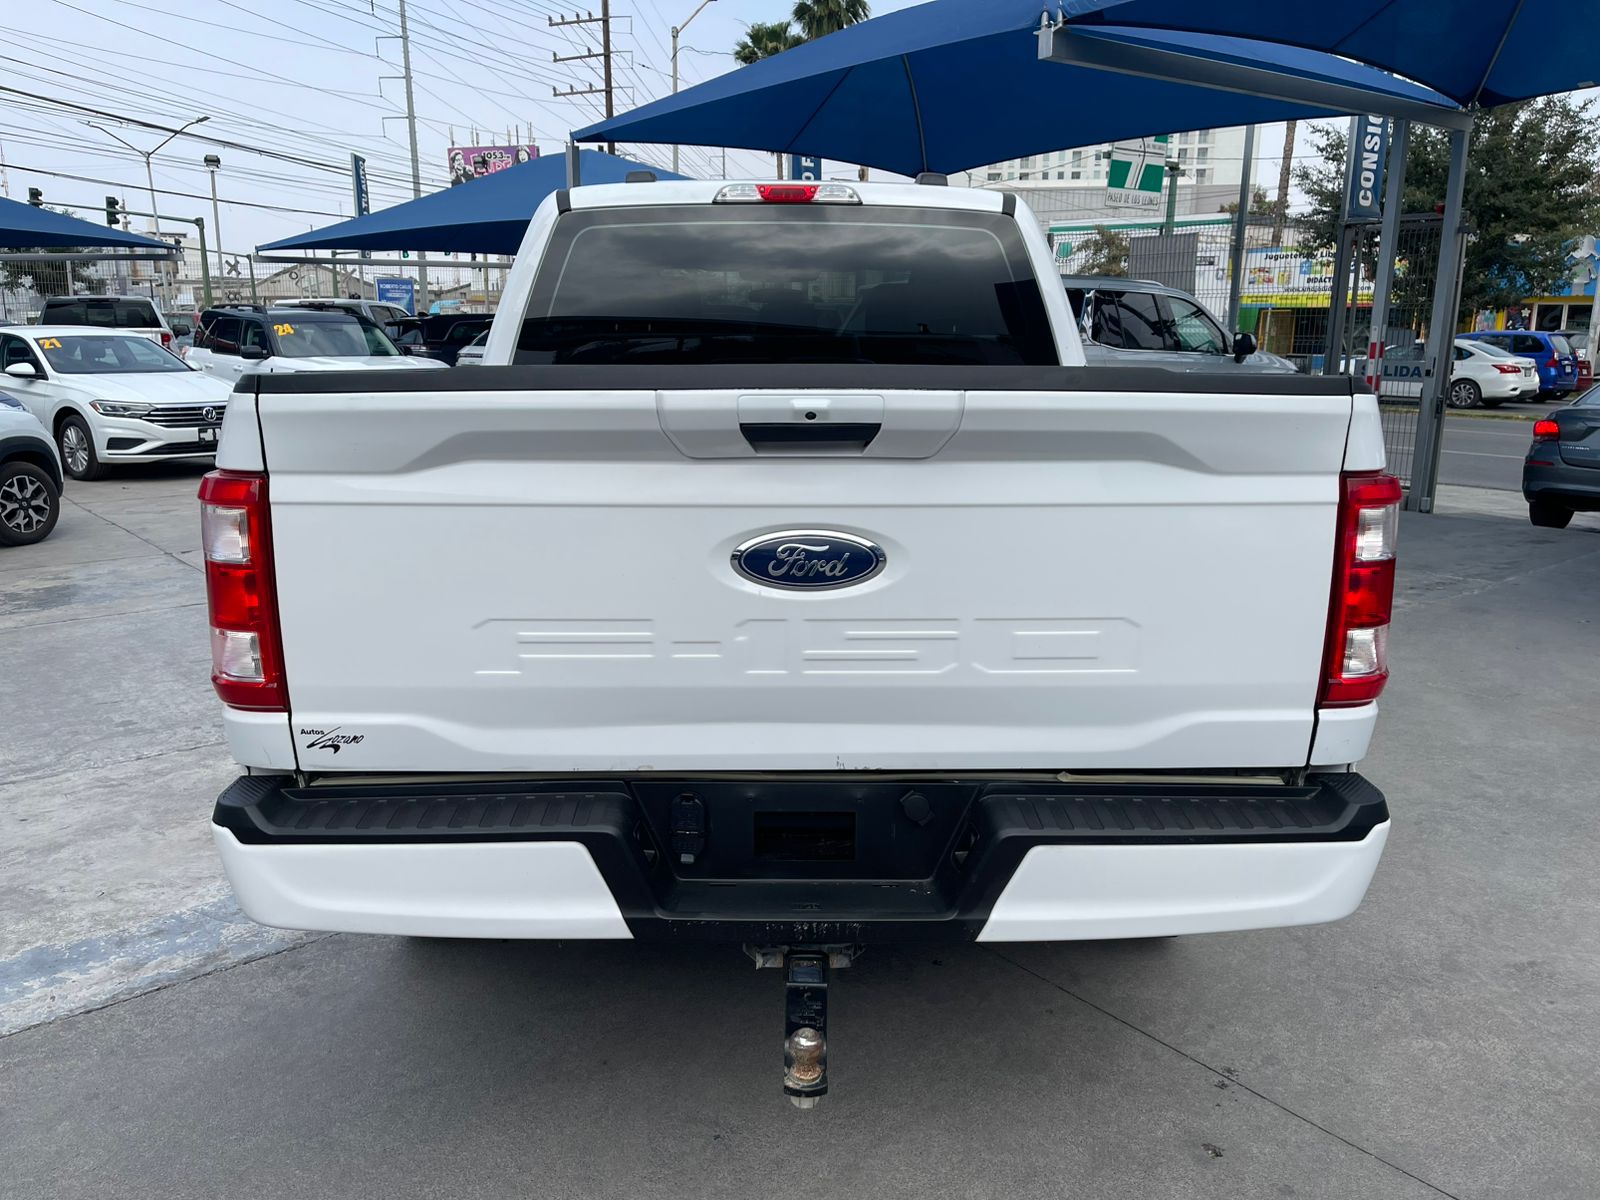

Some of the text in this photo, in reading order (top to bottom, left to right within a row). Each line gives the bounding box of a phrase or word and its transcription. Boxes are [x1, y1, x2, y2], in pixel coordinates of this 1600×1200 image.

[1107, 192, 1123, 203] PASEO
[1124, 193, 1130, 204] DE
[1306, 276, 1333, 284] DIDÁCT
[273, 323, 294, 336] 24
[39, 338, 62, 349] 21
[767, 543, 850, 577] Ford
